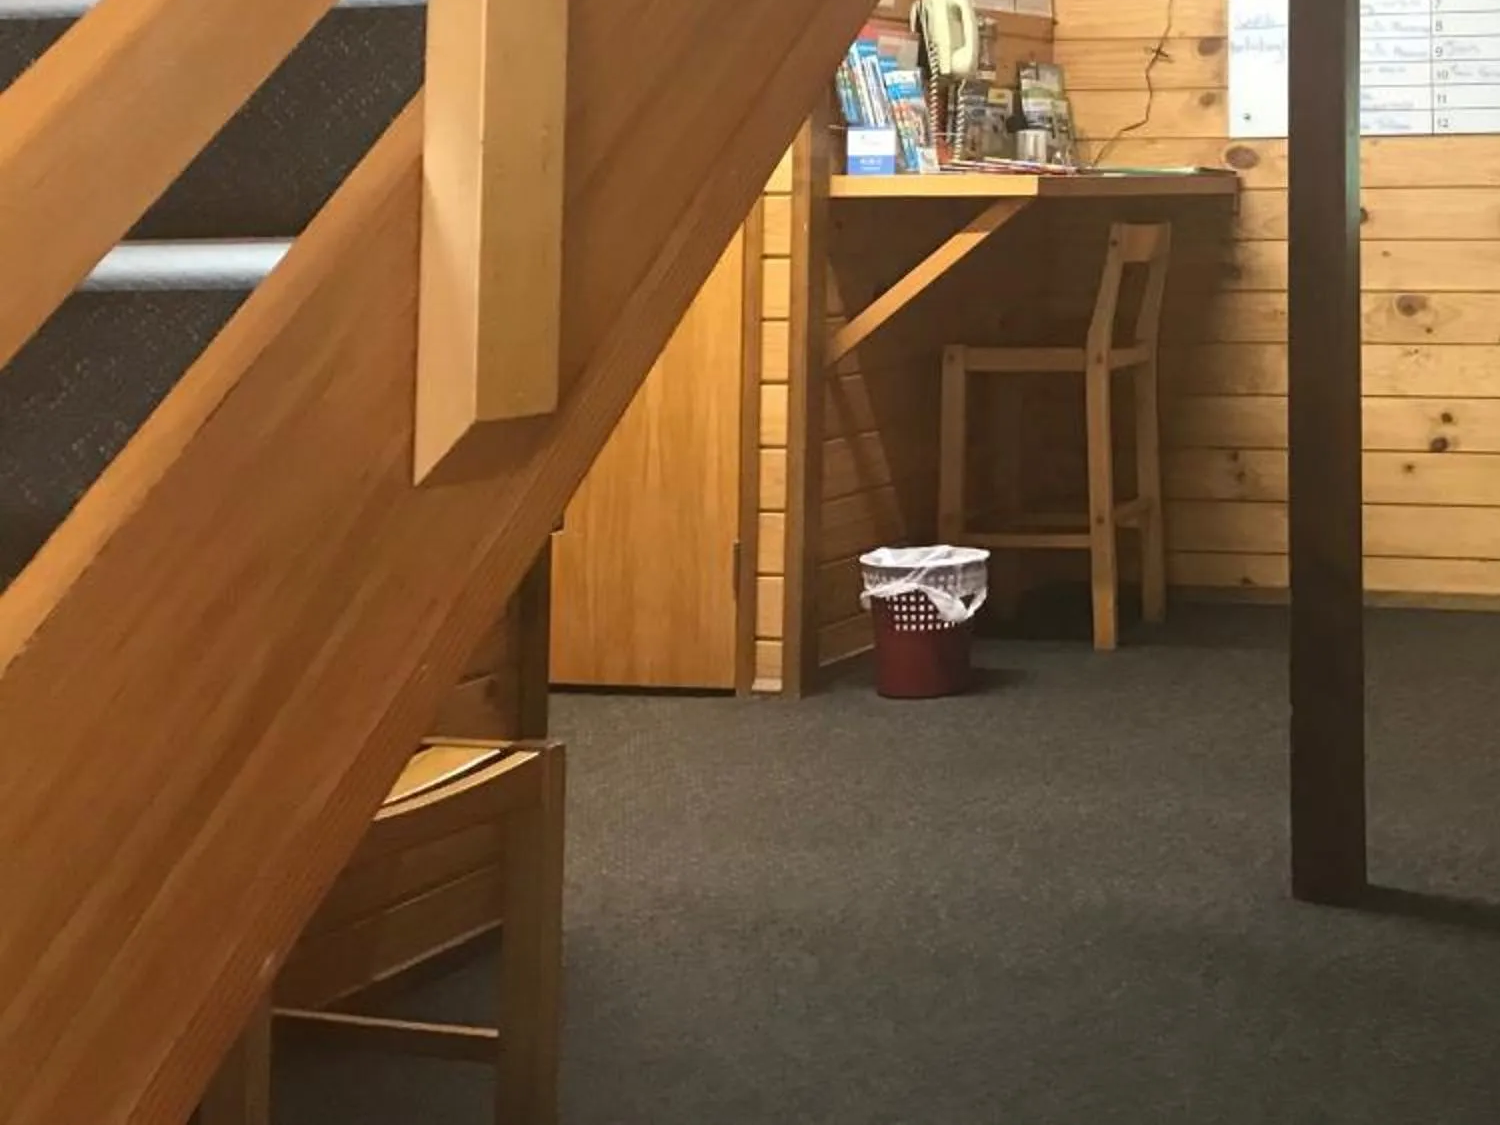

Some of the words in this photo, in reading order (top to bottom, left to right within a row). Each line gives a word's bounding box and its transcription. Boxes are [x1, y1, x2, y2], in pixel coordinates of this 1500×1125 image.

[1435, 21, 1443, 32] 8
[1435, 46, 1443, 57] 9
[1437, 70, 1449, 80] 10
[1437, 118, 1449, 128] 12
